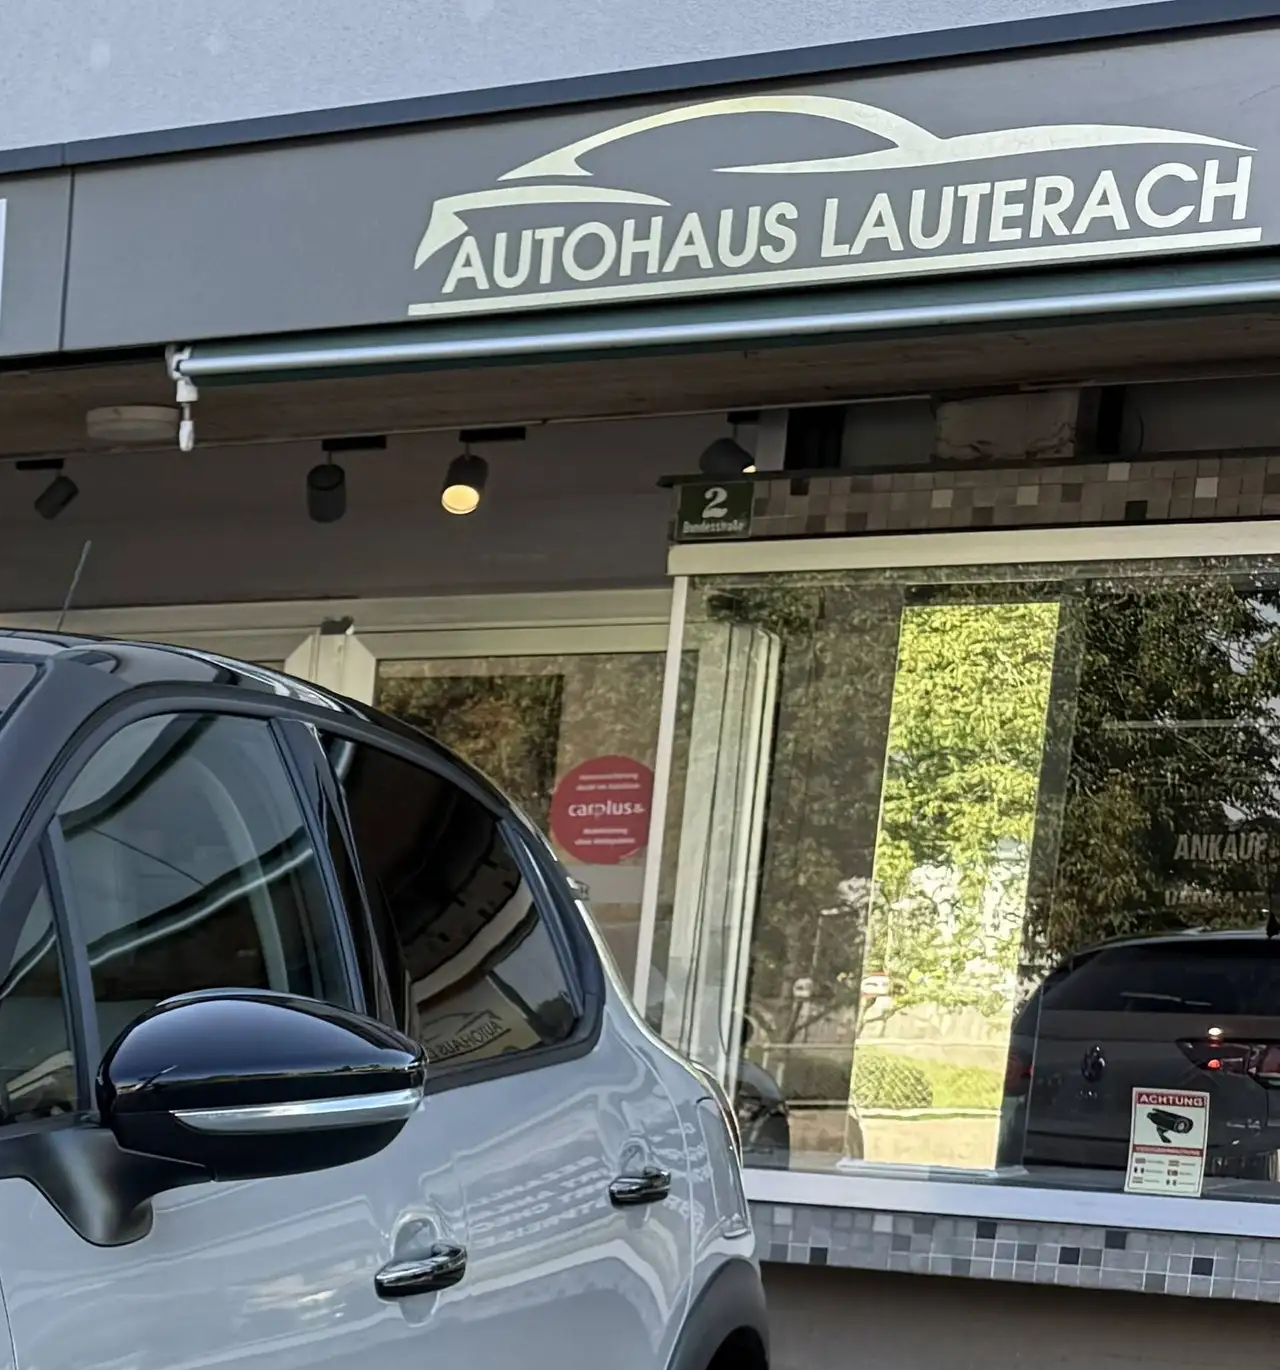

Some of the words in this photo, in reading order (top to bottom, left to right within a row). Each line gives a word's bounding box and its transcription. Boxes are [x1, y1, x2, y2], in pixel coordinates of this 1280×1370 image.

[441, 199, 798, 294] AUTOHAUS
[821, 154, 1255, 258] LAUTERACH
[702, 486, 728, 518] 2
[1139, 1093, 1204, 1107] ACHTUNG
